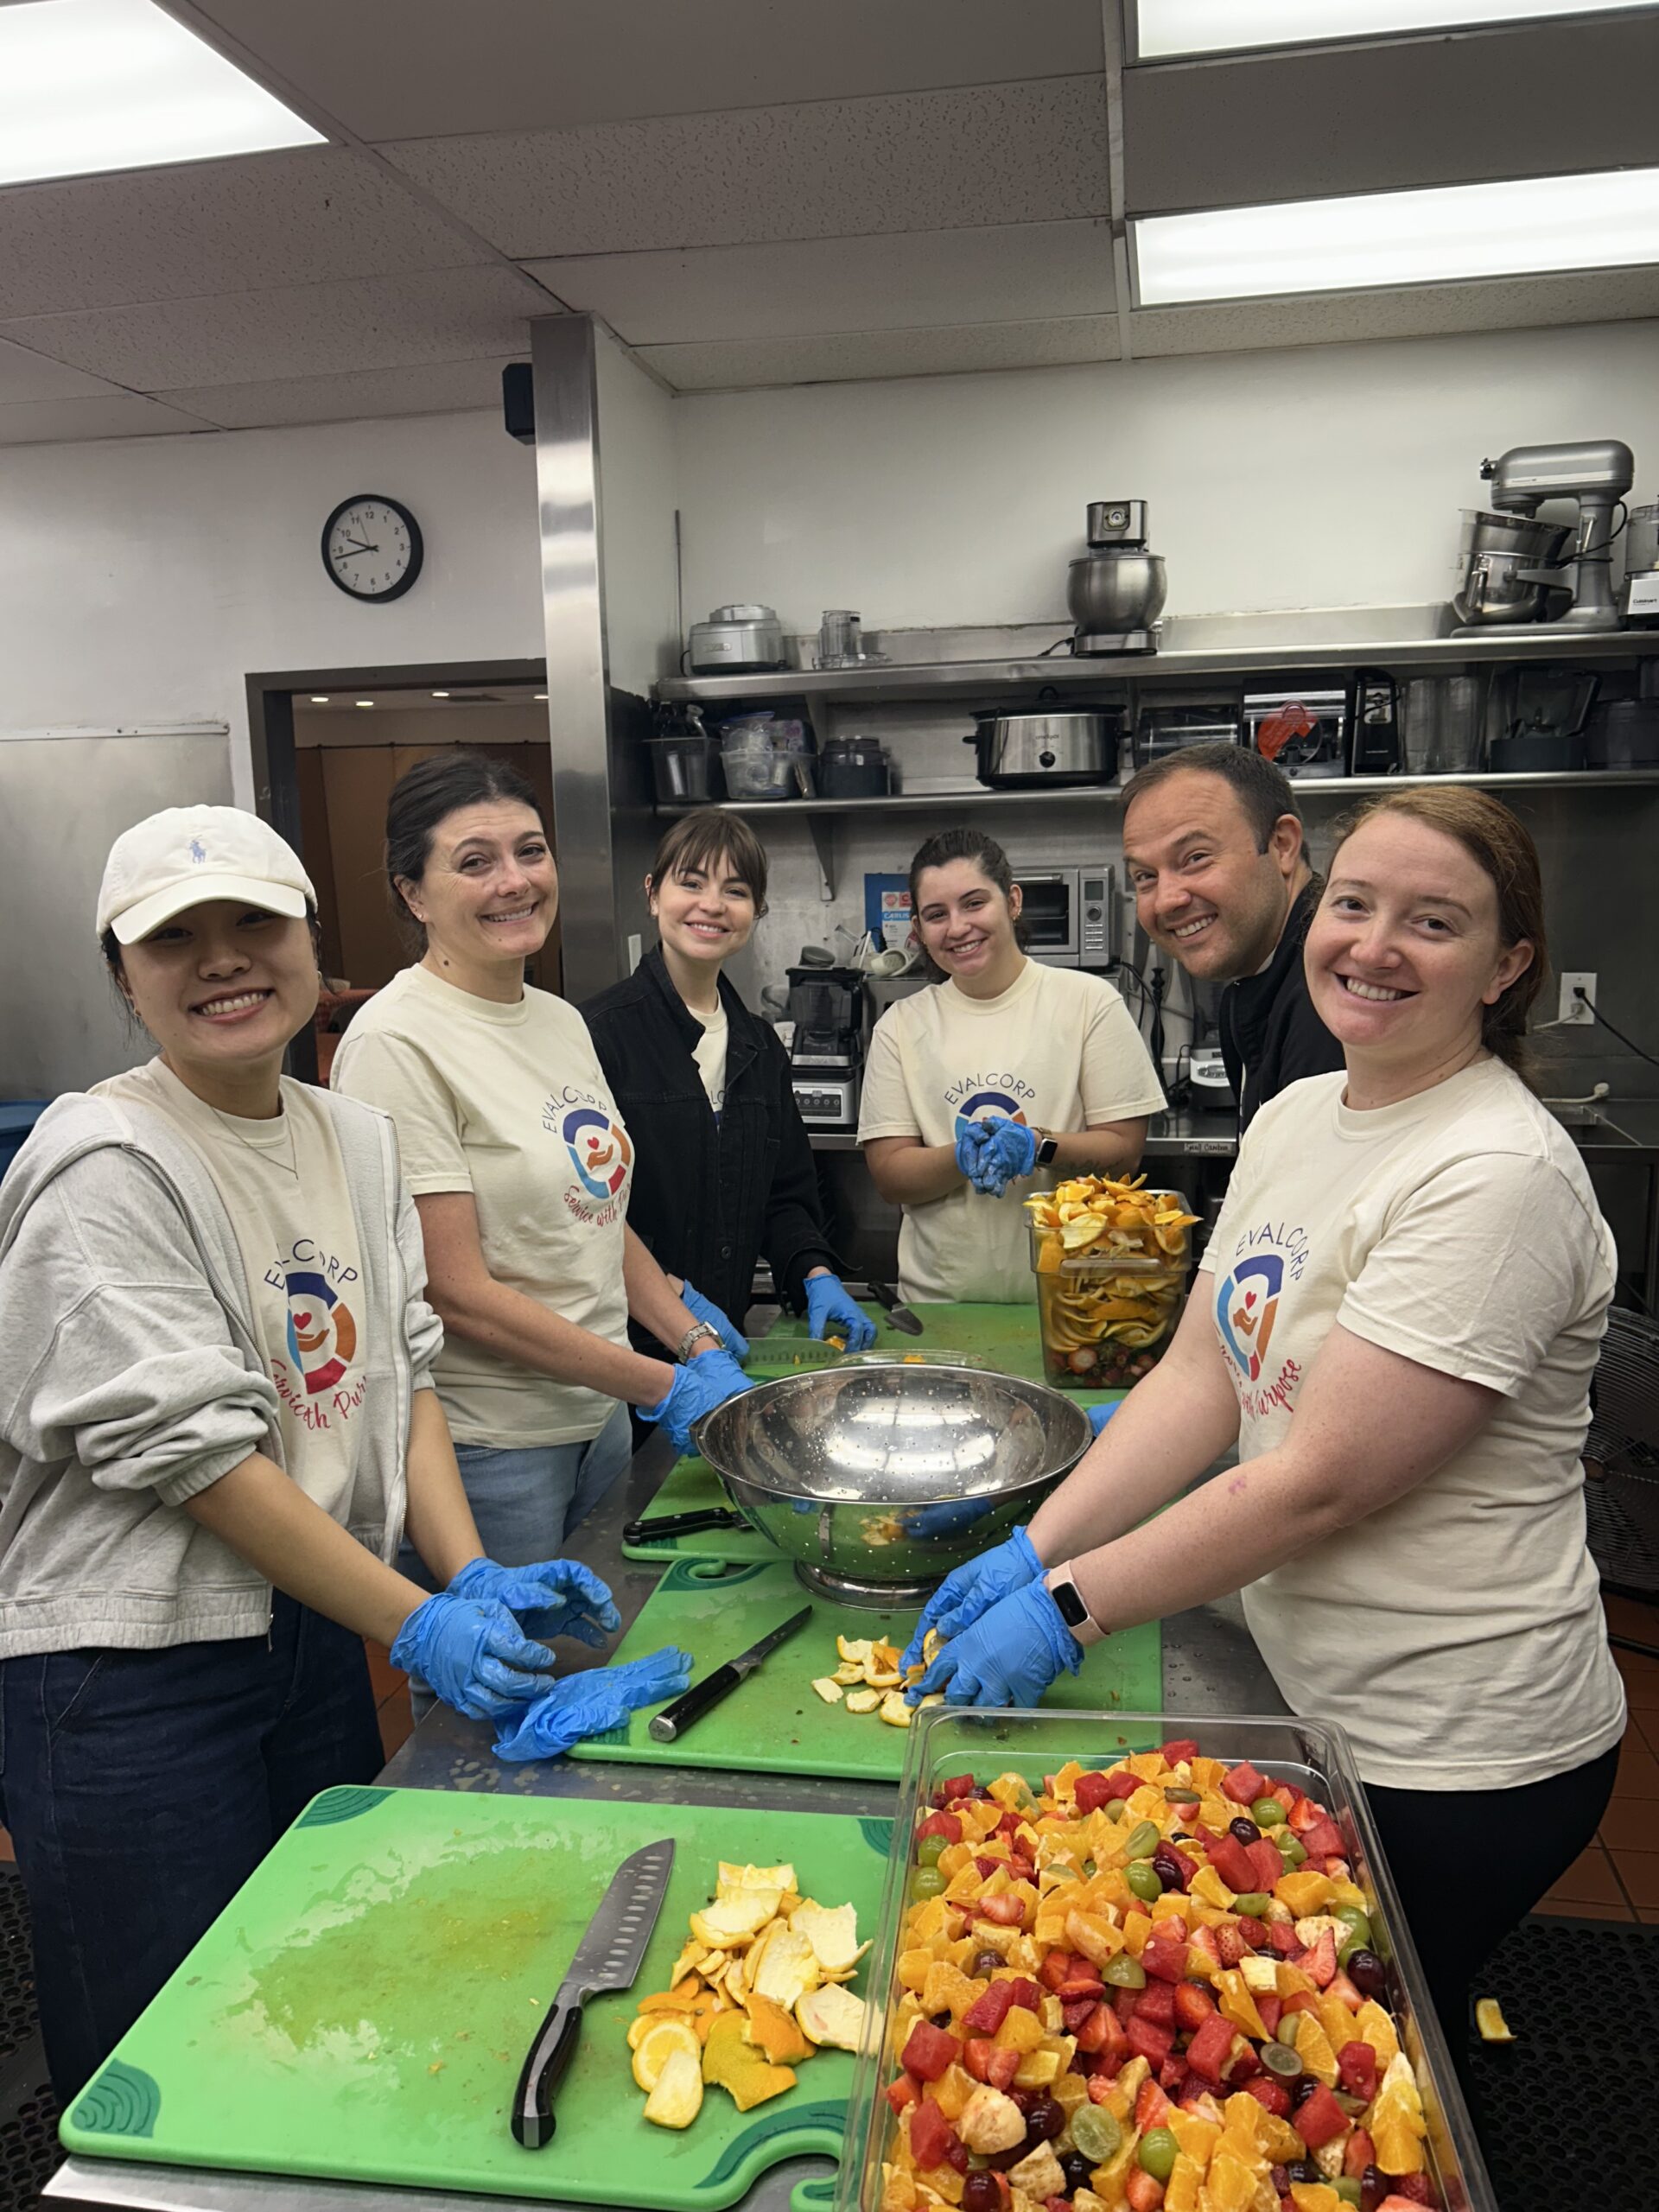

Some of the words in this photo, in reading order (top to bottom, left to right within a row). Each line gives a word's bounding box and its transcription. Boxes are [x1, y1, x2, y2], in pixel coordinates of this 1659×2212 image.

[341, 529, 351, 537] 10
[352, 516, 359, 524] 11
[944, 1072, 1036, 1105] EVALCORP
[563, 1185, 594, 1224] Service
[596, 1199, 618, 1227] with
[1236, 1222, 1309, 1281] EVALCORP
[1255, 1358, 1302, 1420] urpose
